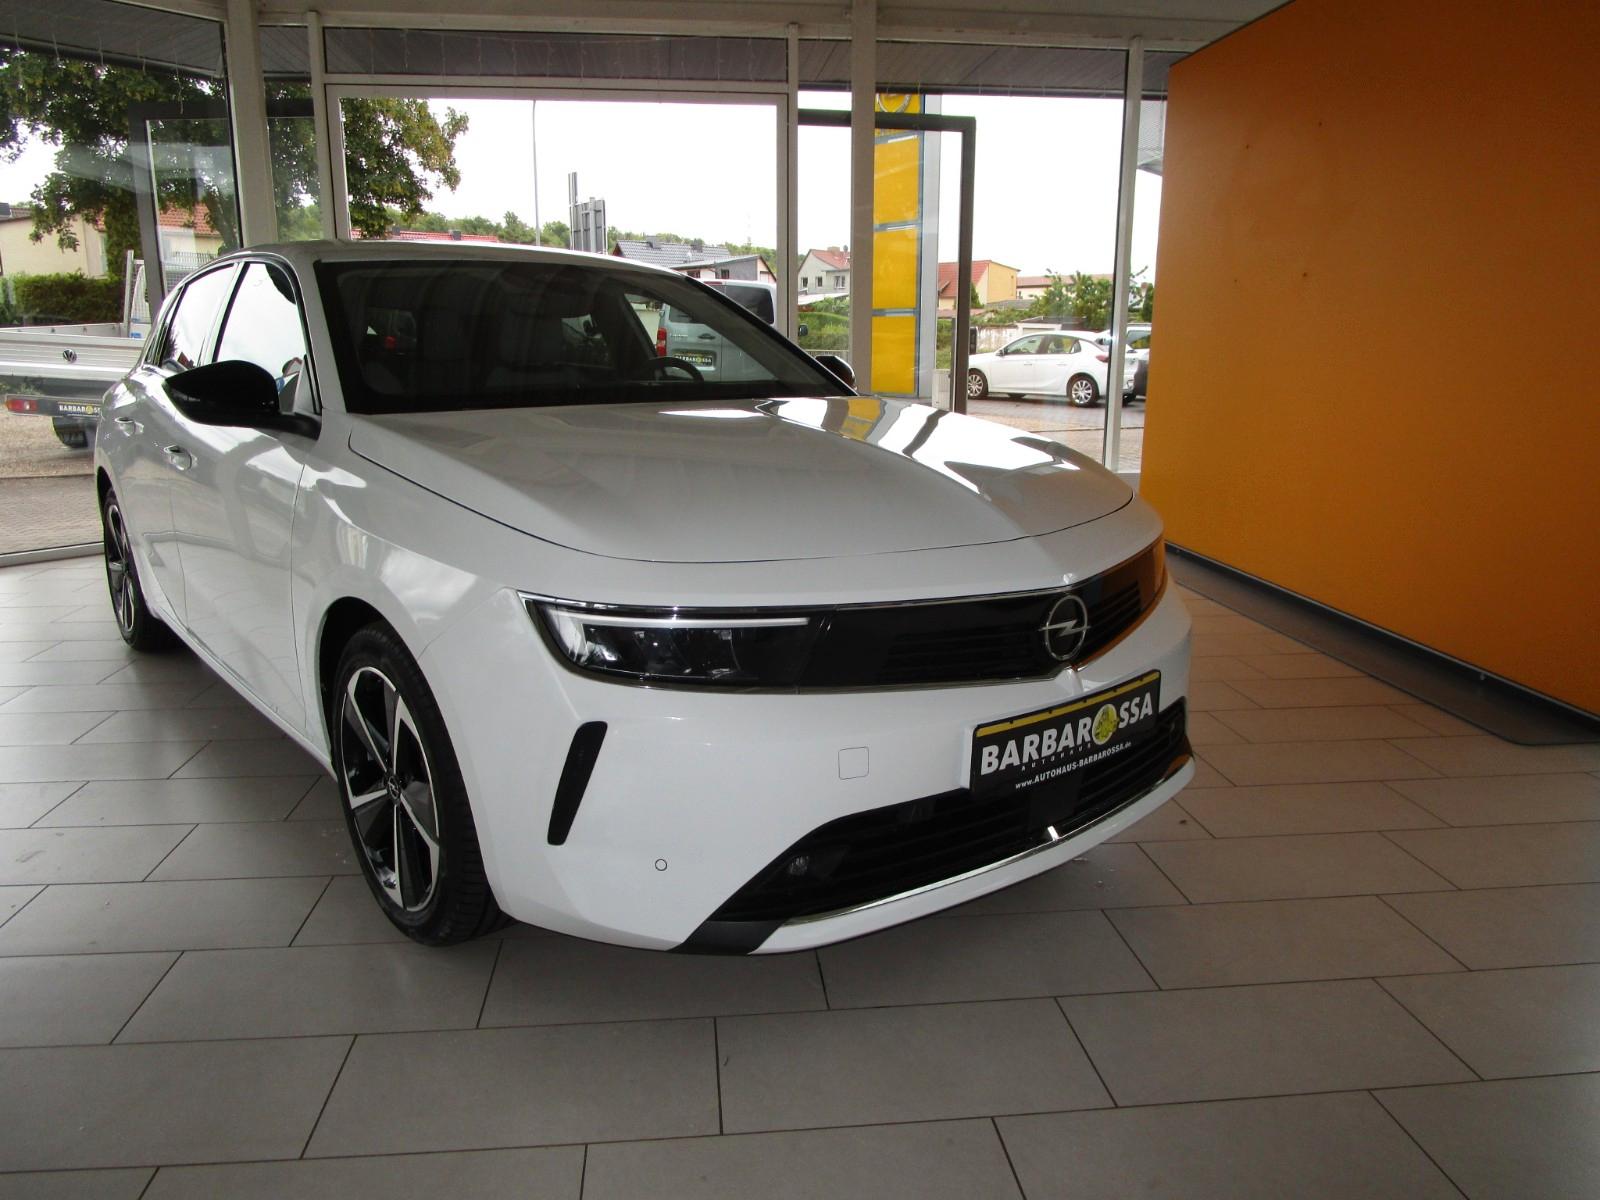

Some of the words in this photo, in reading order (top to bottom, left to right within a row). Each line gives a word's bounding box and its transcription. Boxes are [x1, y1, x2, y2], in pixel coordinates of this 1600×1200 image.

[59, 404, 101, 415] BARBAROS
[980, 692, 1153, 776] BARBAROSSA
[1015, 741, 1132, 789] www.AUTOHAUS-BARBAROSSA.de
[1021, 743, 1091, 771] AUTOHAUS
